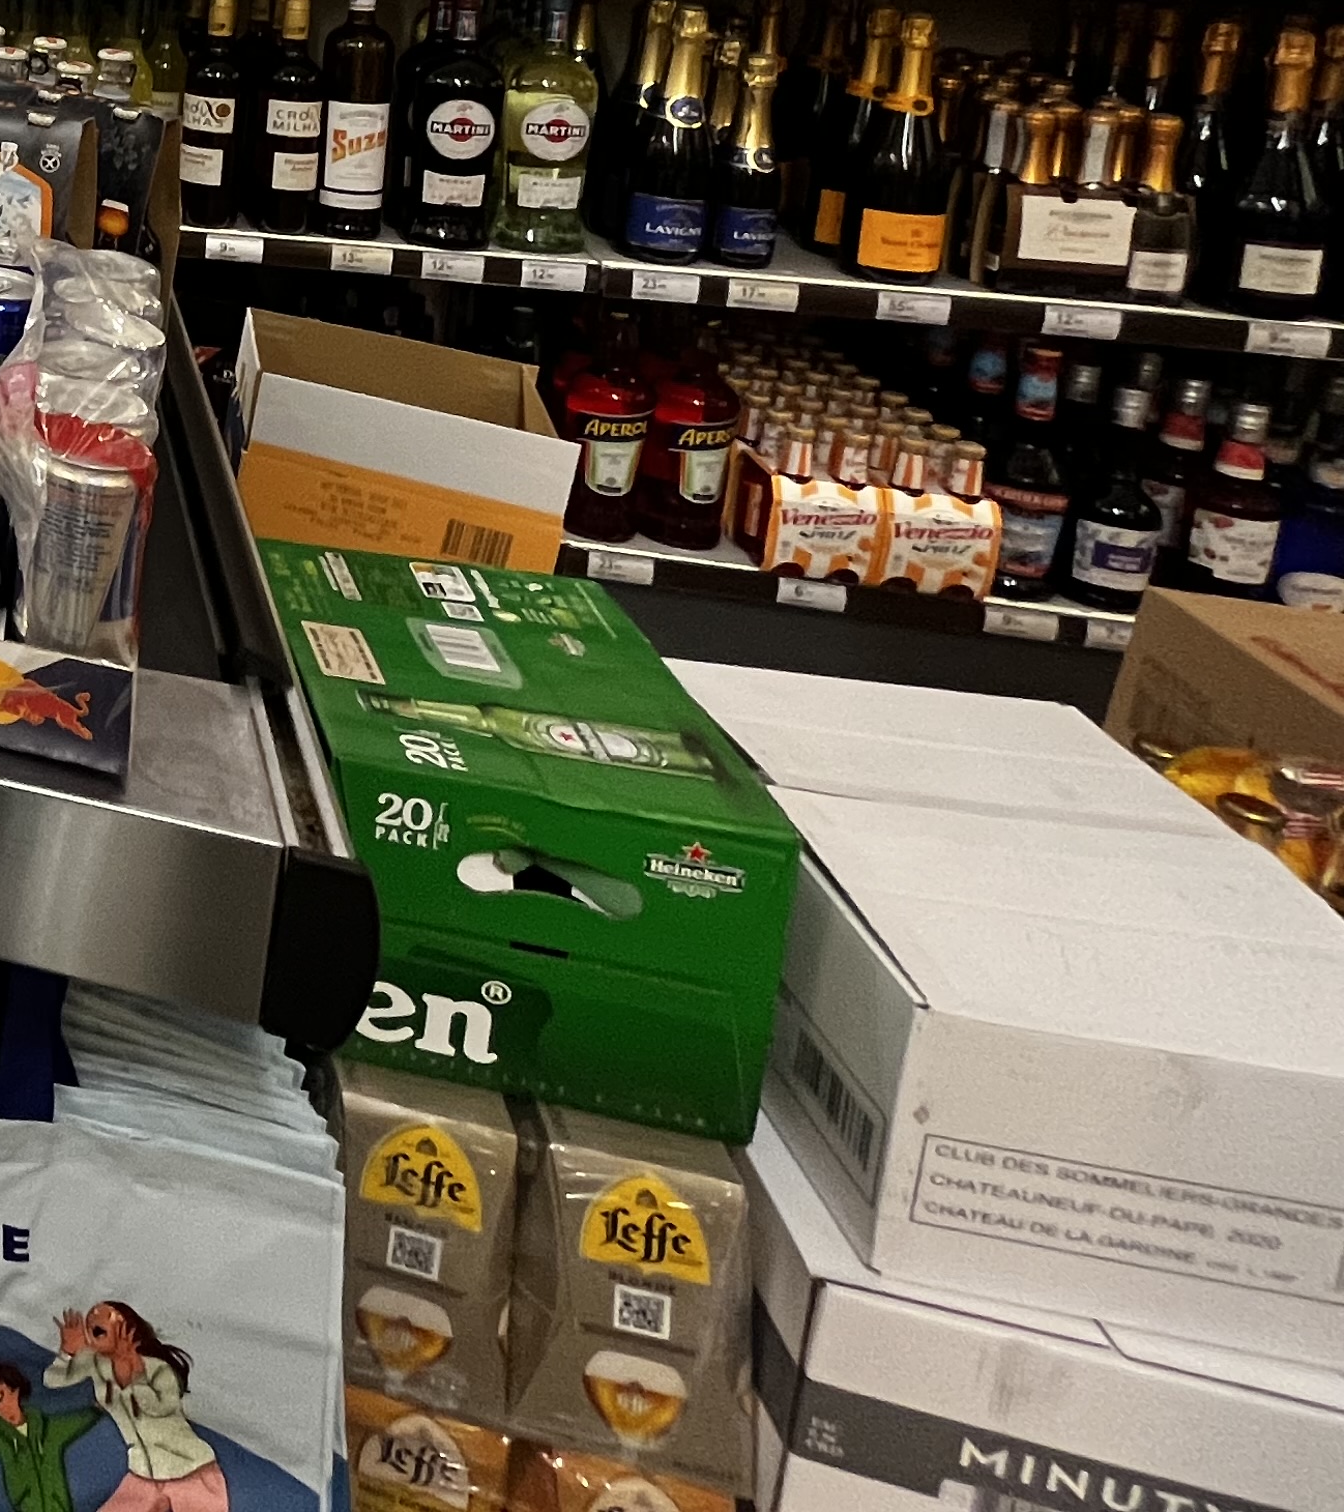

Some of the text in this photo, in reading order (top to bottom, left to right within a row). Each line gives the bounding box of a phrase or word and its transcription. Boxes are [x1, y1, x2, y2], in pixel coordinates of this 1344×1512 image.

[432, 122, 490, 136] MARTINI
[527, 123, 585, 137] MARTINI
[375, 792, 433, 831] 20
[375, 825, 428, 848] PACK
[650, 858, 738, 887] Heineken
[934, 1143, 1050, 1177] CLUB DES
[383, 1152, 467, 1207] Leffe
[600, 1207, 691, 1263] Leffe
[923, 1200, 1024, 1230] CHATEAU
[1030, 1220, 1058, 1237] DE
[1065, 1228, 1093, 1245] LA
[958, 1436, 1224, 1512] MINUT
